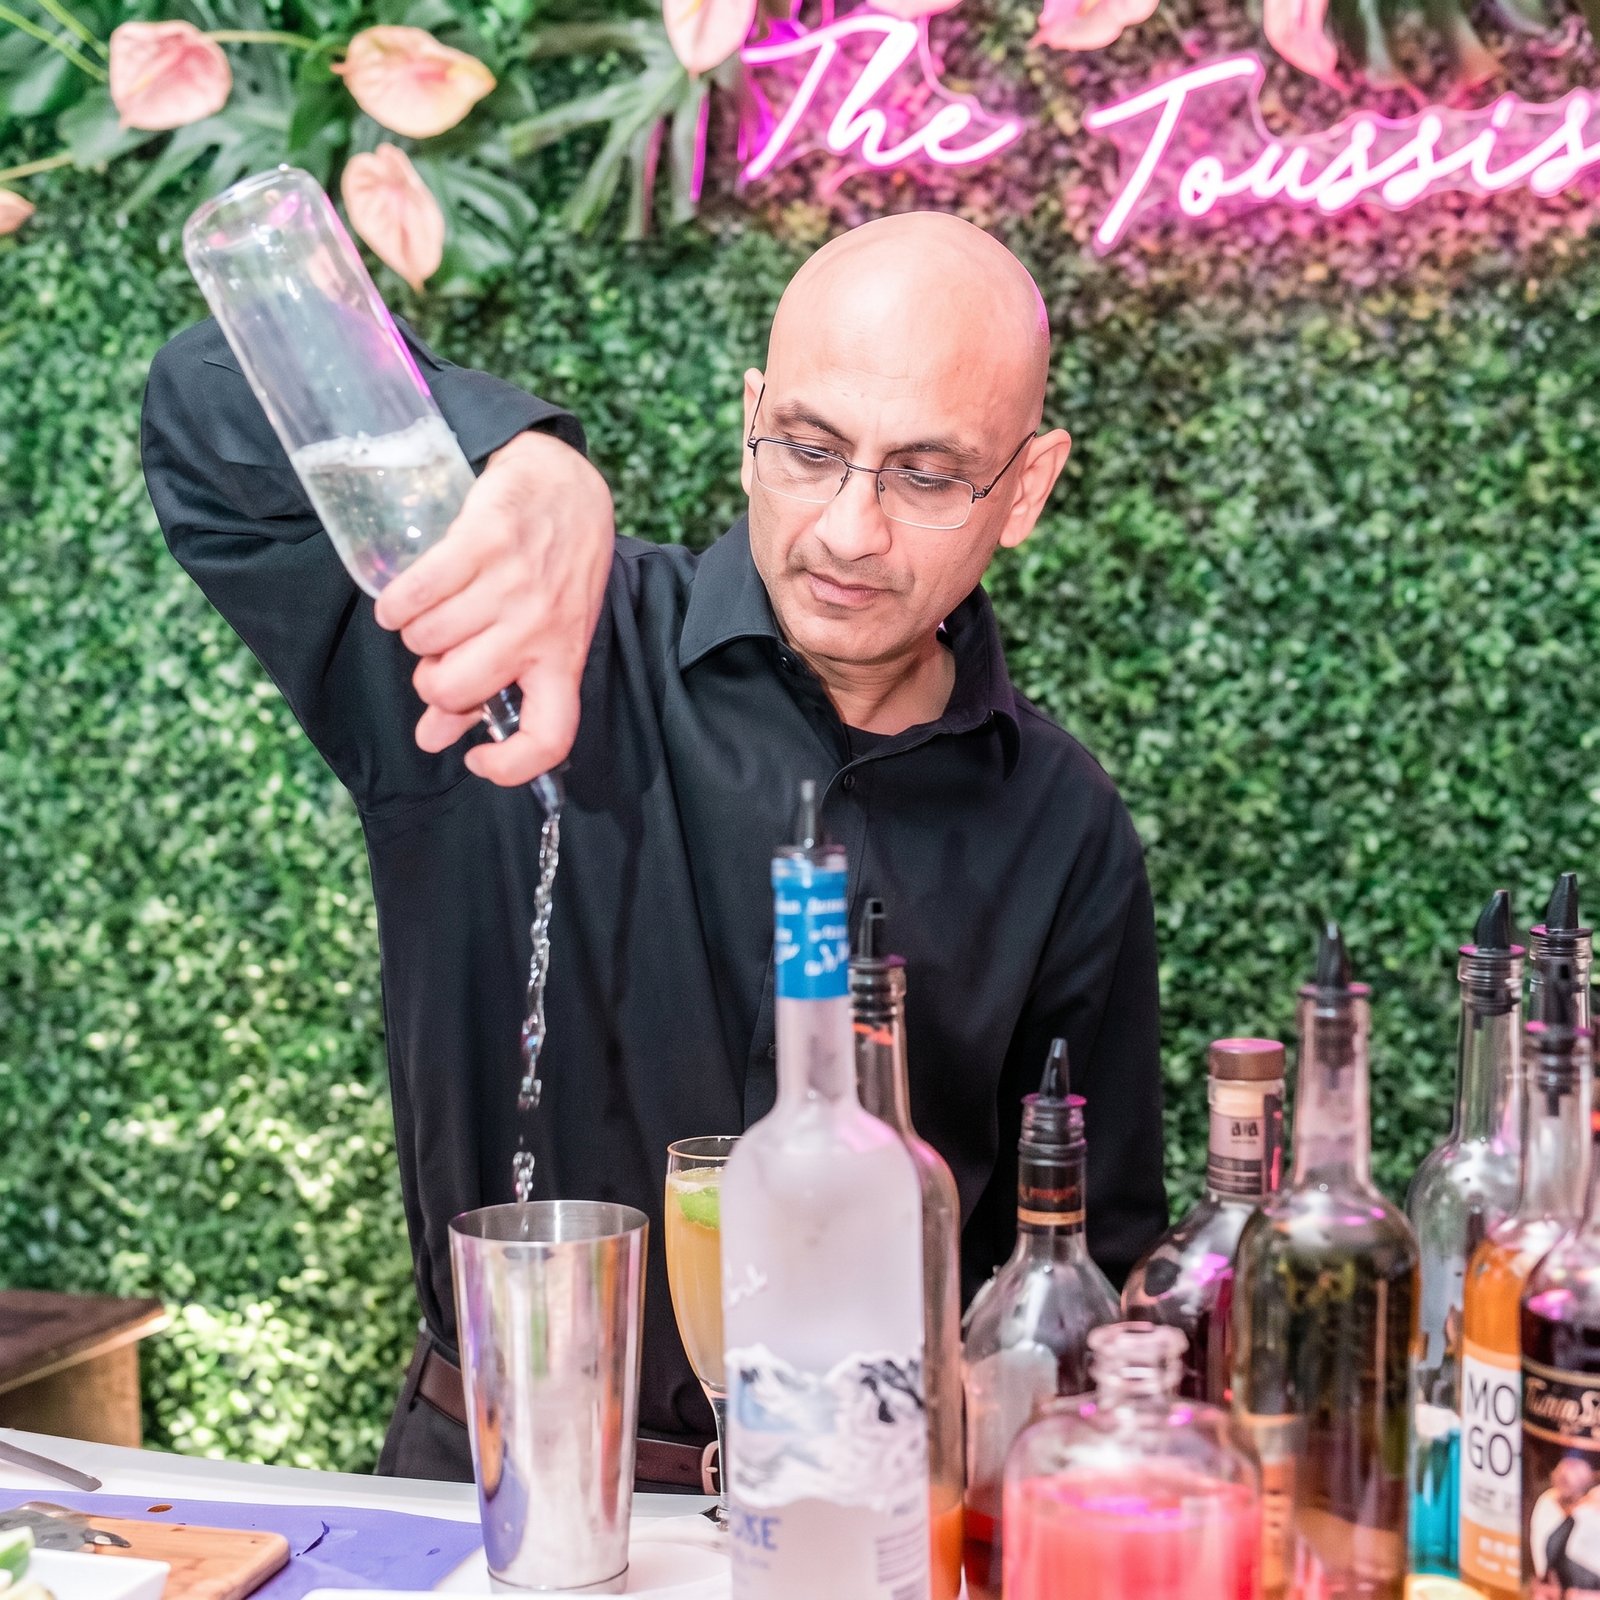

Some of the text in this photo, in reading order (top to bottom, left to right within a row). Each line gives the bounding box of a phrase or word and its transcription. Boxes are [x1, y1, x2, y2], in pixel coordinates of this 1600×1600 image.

[740, 13, 1021, 181] The
[1467, 1373, 1518, 1426] MO
[1469, 1425, 1513, 1477] GO
